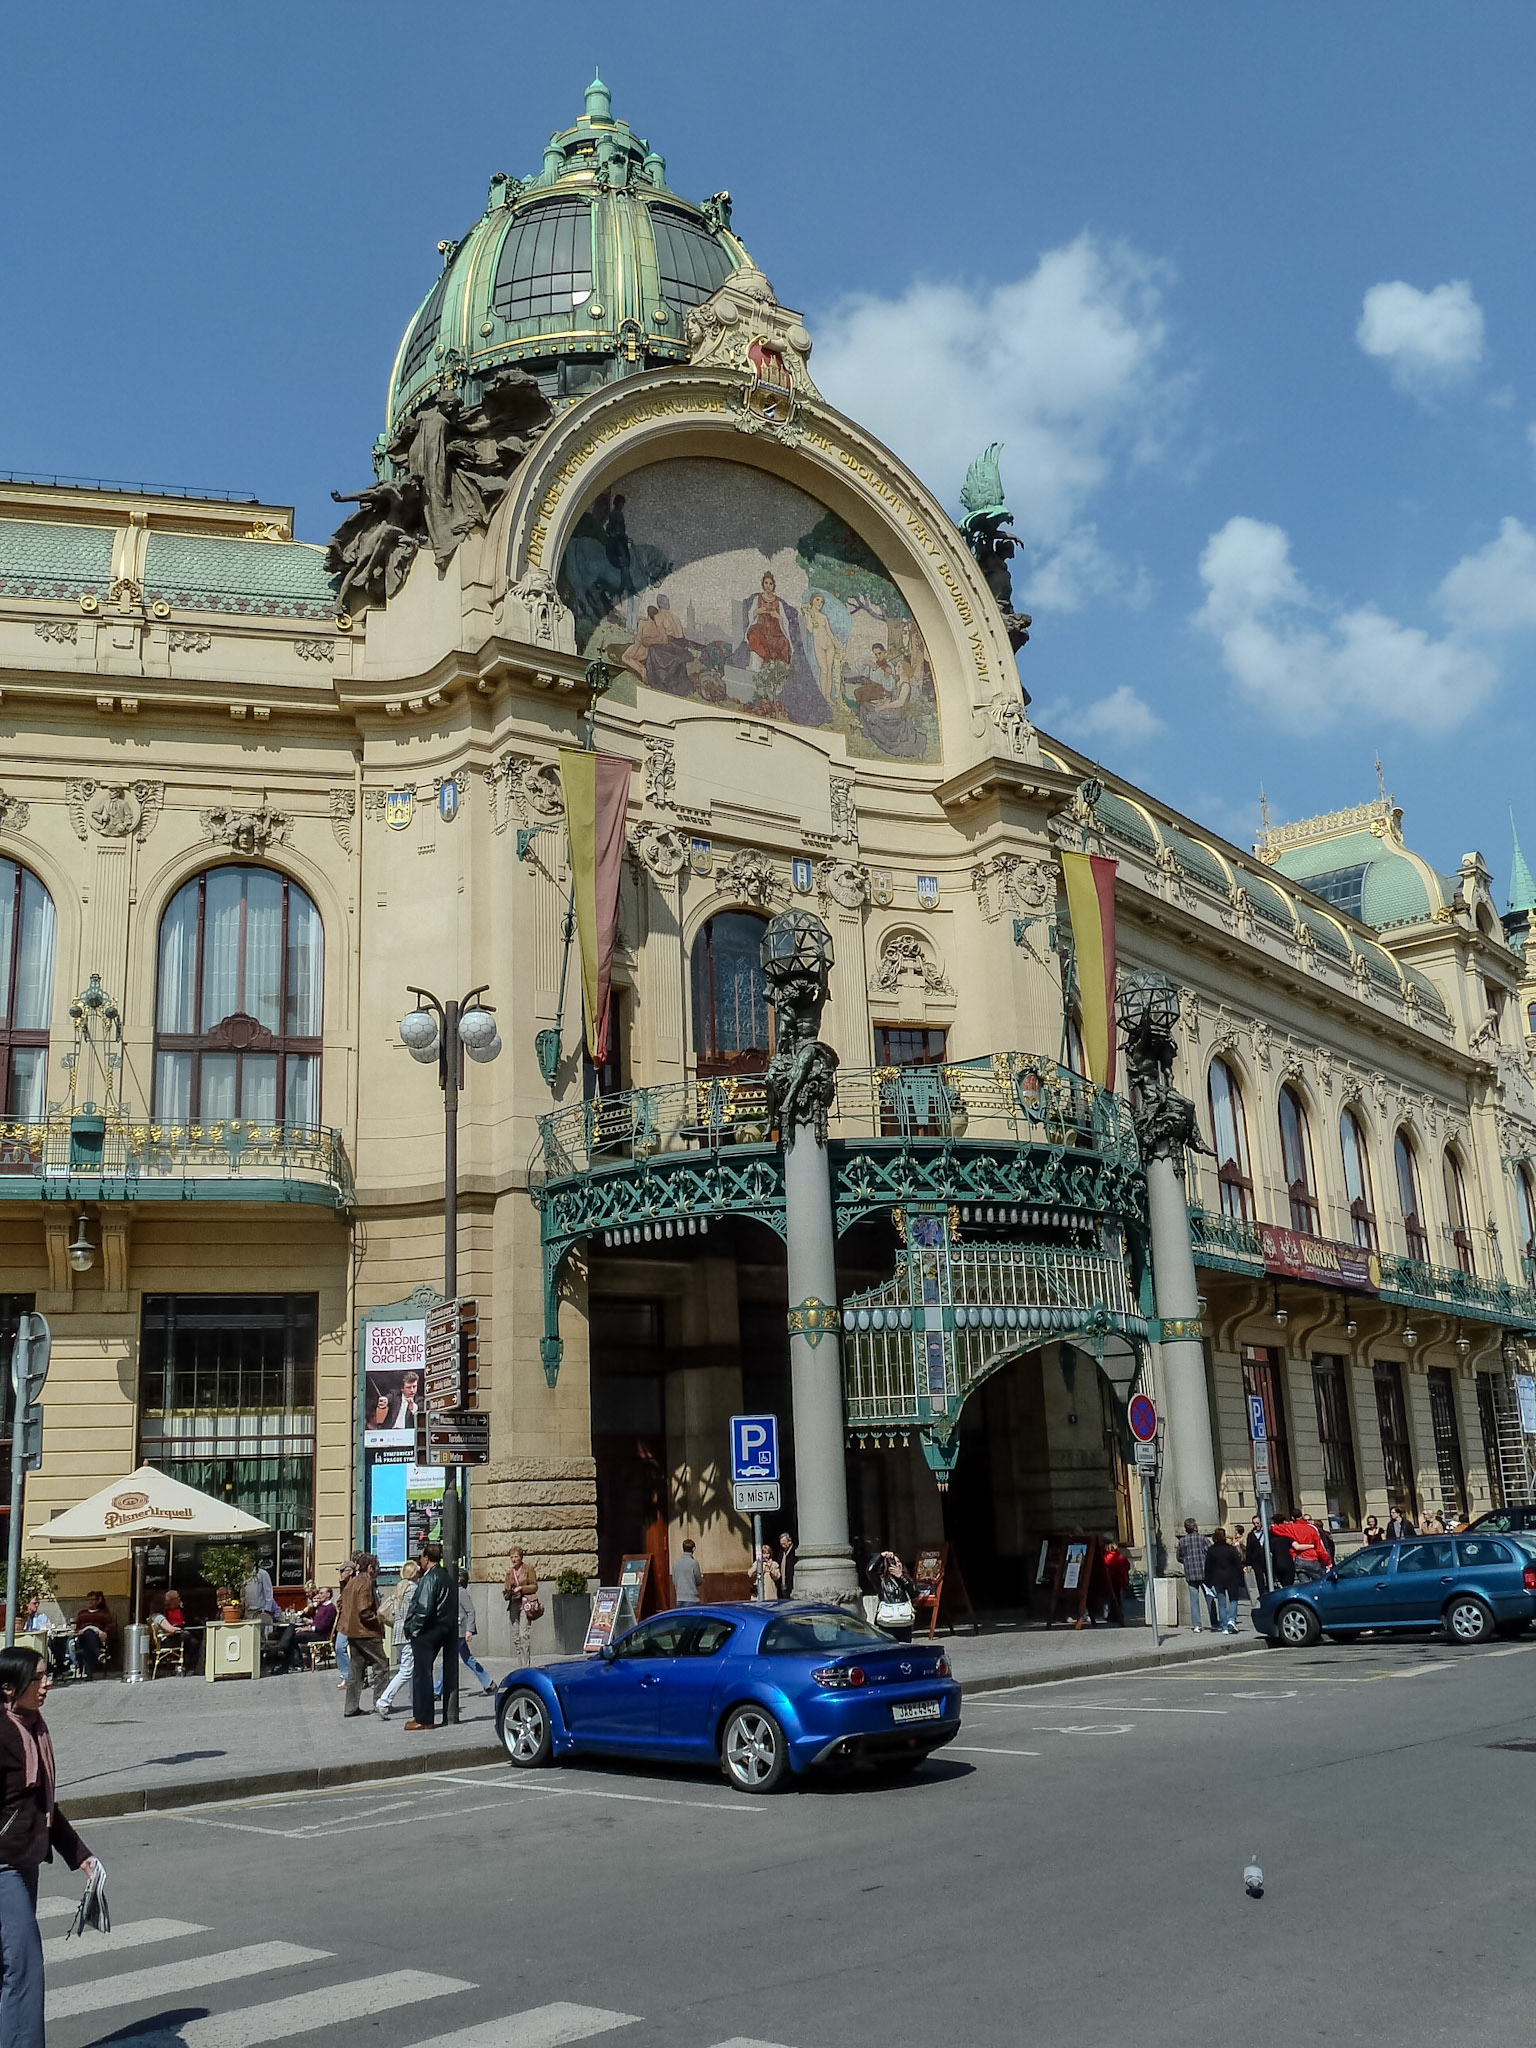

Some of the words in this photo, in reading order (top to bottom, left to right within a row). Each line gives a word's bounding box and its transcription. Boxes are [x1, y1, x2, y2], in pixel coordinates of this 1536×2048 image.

[371, 1326, 404, 1338] ČESKÝ
[372, 1335, 419, 1346] NÁRODNÍ
[371, 1353, 422, 1364] ORCHESTR
[1252, 1401, 1261, 1427] P
[741, 1424, 767, 1461] P
[738, 1492, 744, 1502] 3
[747, 1489, 775, 1502] MÍSTA
[104, 1511, 150, 1529] Pilsner
[148, 1506, 193, 1520] Urquell
